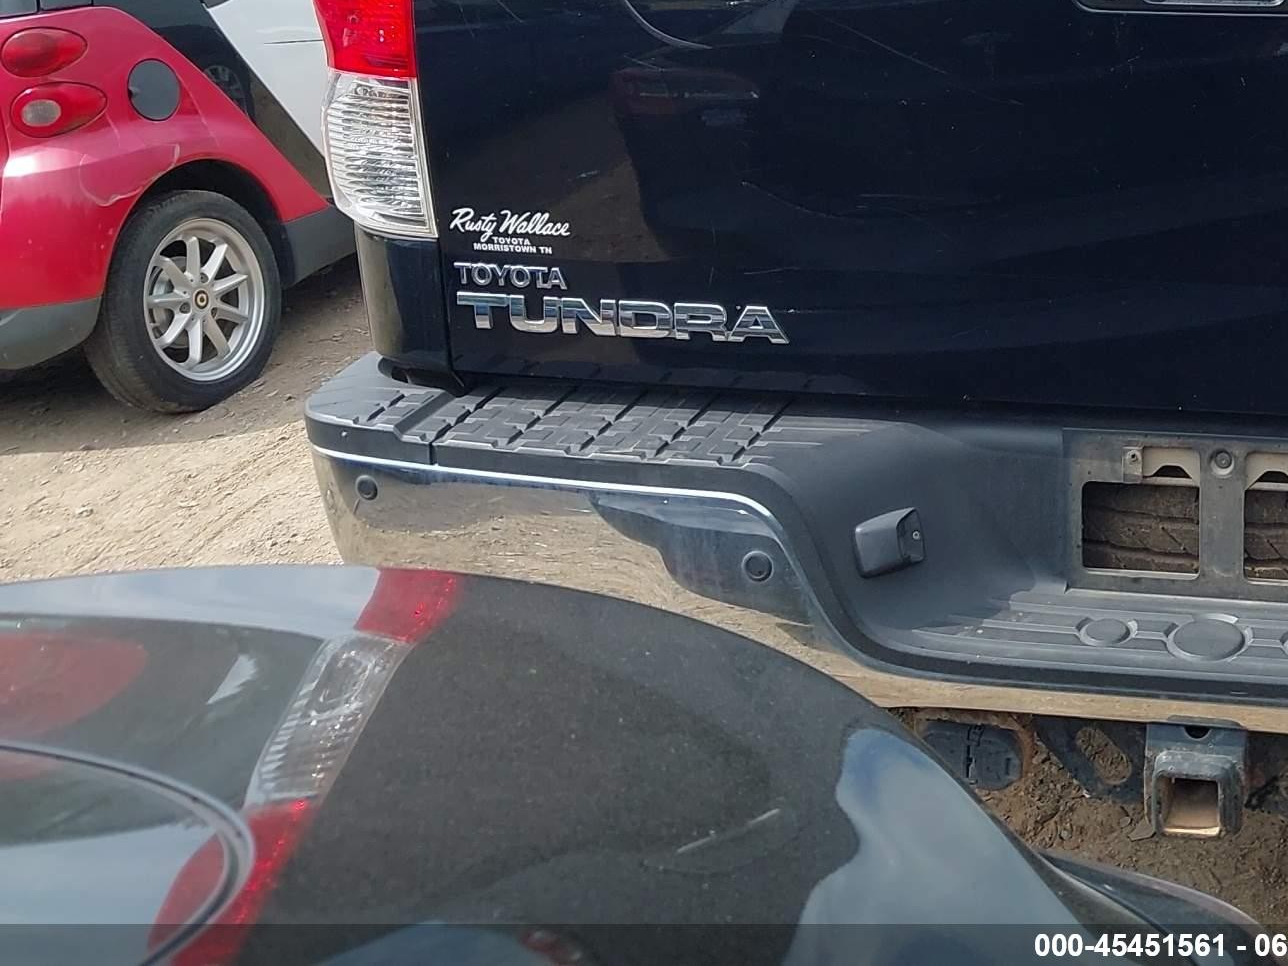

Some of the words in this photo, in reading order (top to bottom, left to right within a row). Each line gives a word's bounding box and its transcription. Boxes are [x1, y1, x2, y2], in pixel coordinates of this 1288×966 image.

[449, 207, 498, 242] Rusty
[499, 209, 571, 236] Wallace
[473, 242, 537, 253] MORRISTOWN
[538, 246, 552, 254] TN
[491, 236, 531, 245] TOYOTA
[453, 262, 568, 290] TOYOTA
[456, 291, 790, 344] TUNDRA
